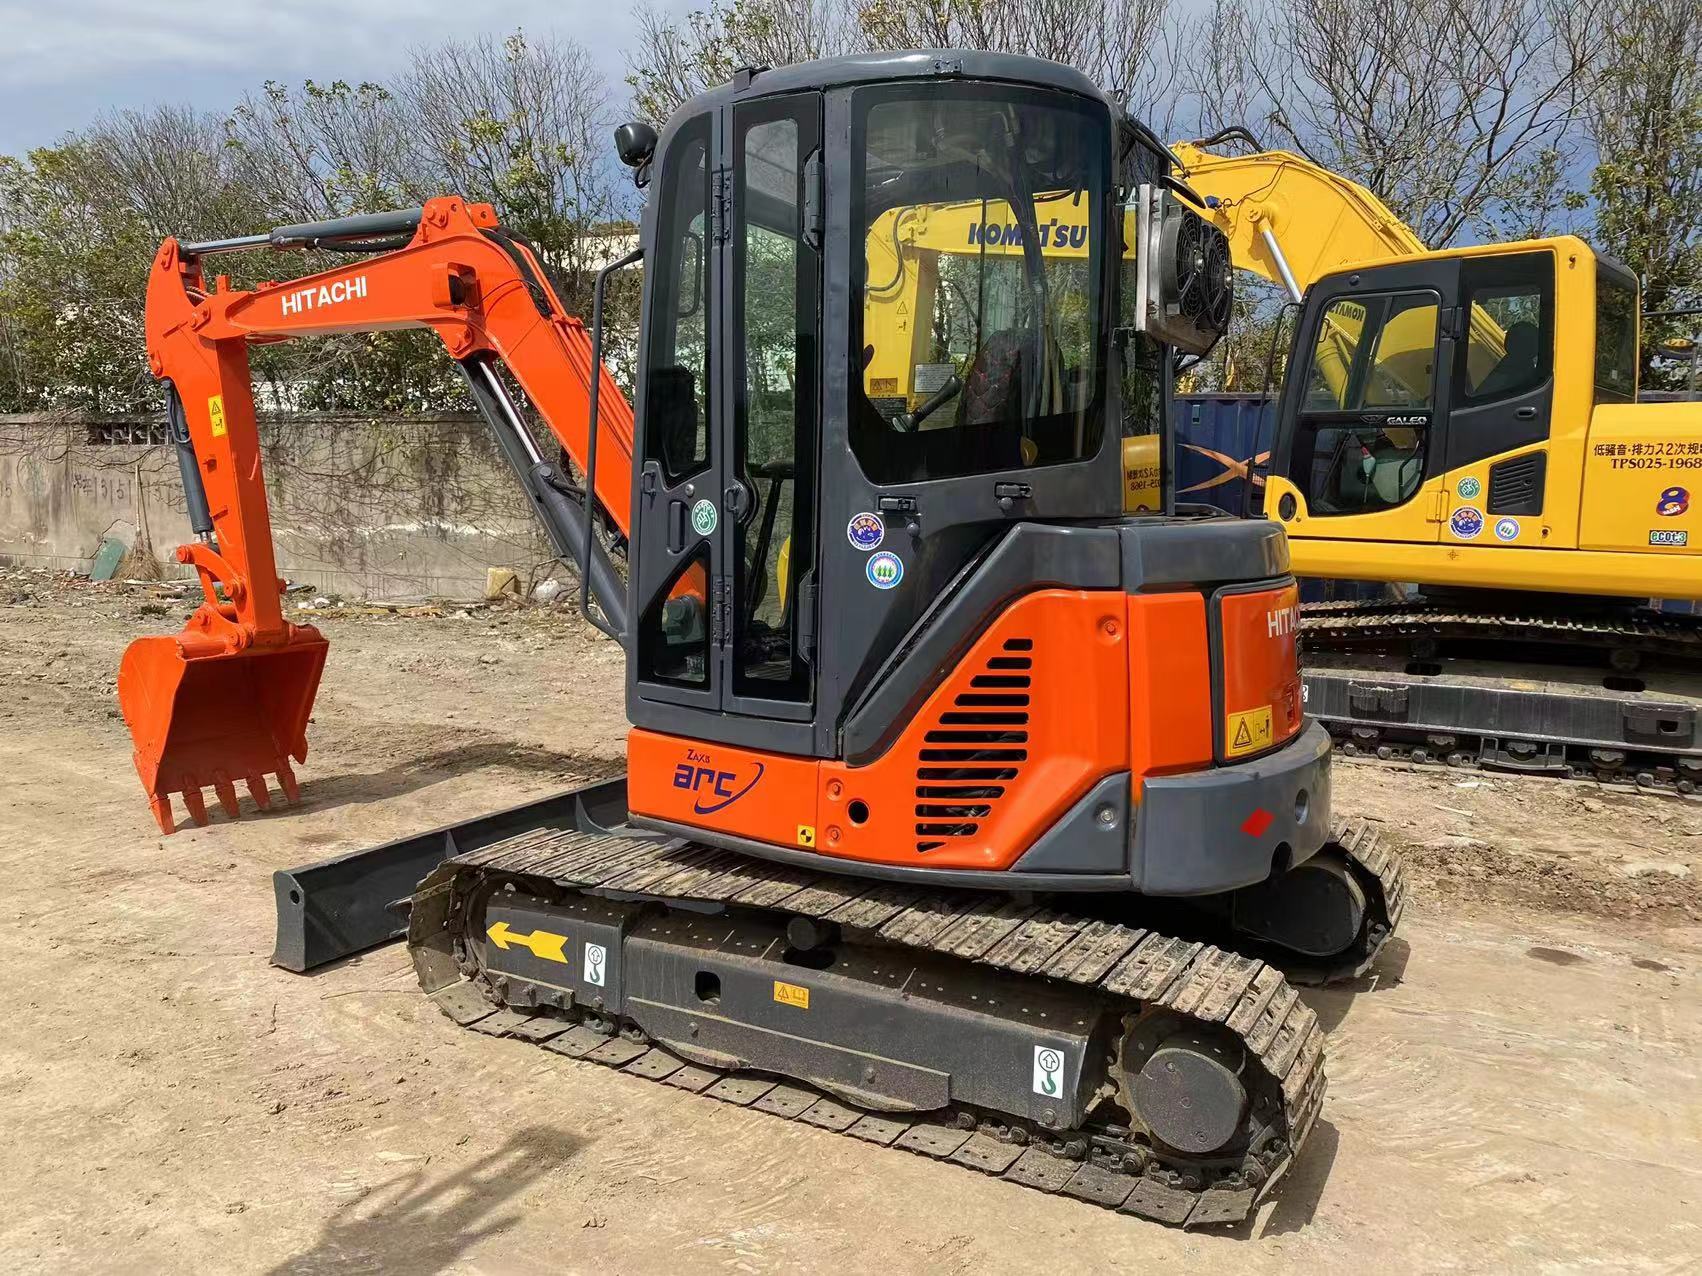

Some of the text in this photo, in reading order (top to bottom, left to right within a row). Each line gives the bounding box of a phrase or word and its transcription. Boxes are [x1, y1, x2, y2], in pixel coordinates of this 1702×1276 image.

[968, 218, 1088, 249] KOMTSU
[281, 275, 367, 316] HITACHI
[1386, 416, 1428, 425] GALEO
[1611, 458, 1702, 469] TPS025-1968
[1651, 531, 1687, 543] ecot3
[673, 763, 737, 798] arc
